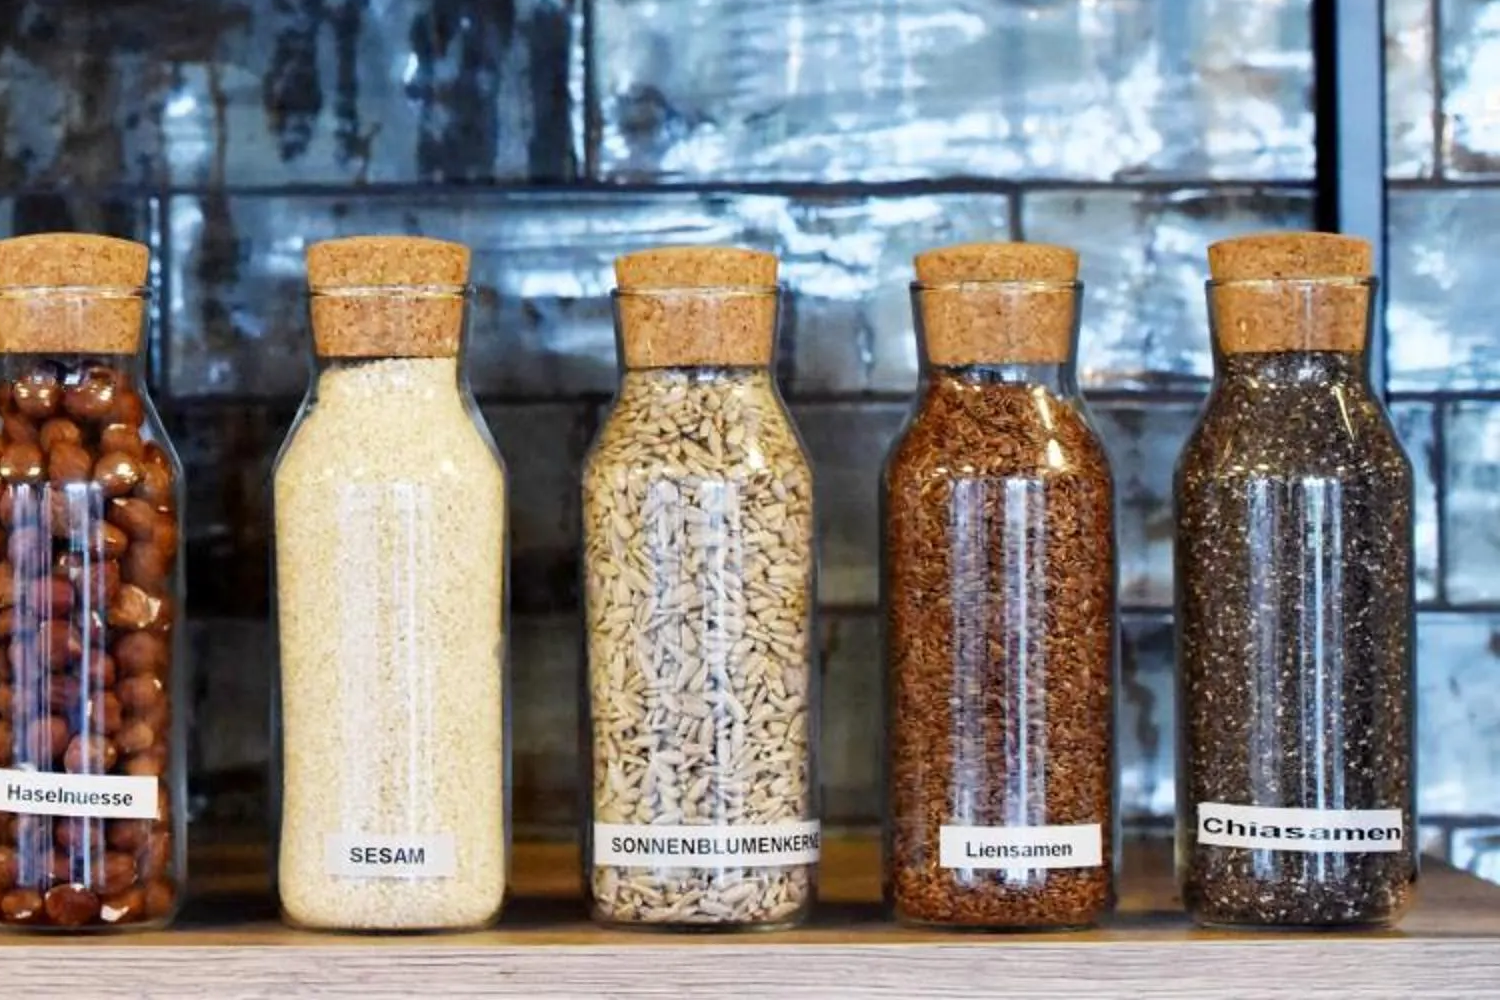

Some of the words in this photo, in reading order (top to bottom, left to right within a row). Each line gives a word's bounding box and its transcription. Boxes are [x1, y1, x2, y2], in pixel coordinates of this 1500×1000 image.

[6, 783, 134, 807] Haselnuesse
[1203, 816, 1401, 842] Chiasamen
[349, 846, 426, 865] SESAM
[965, 841, 1074, 859] Liensamen
